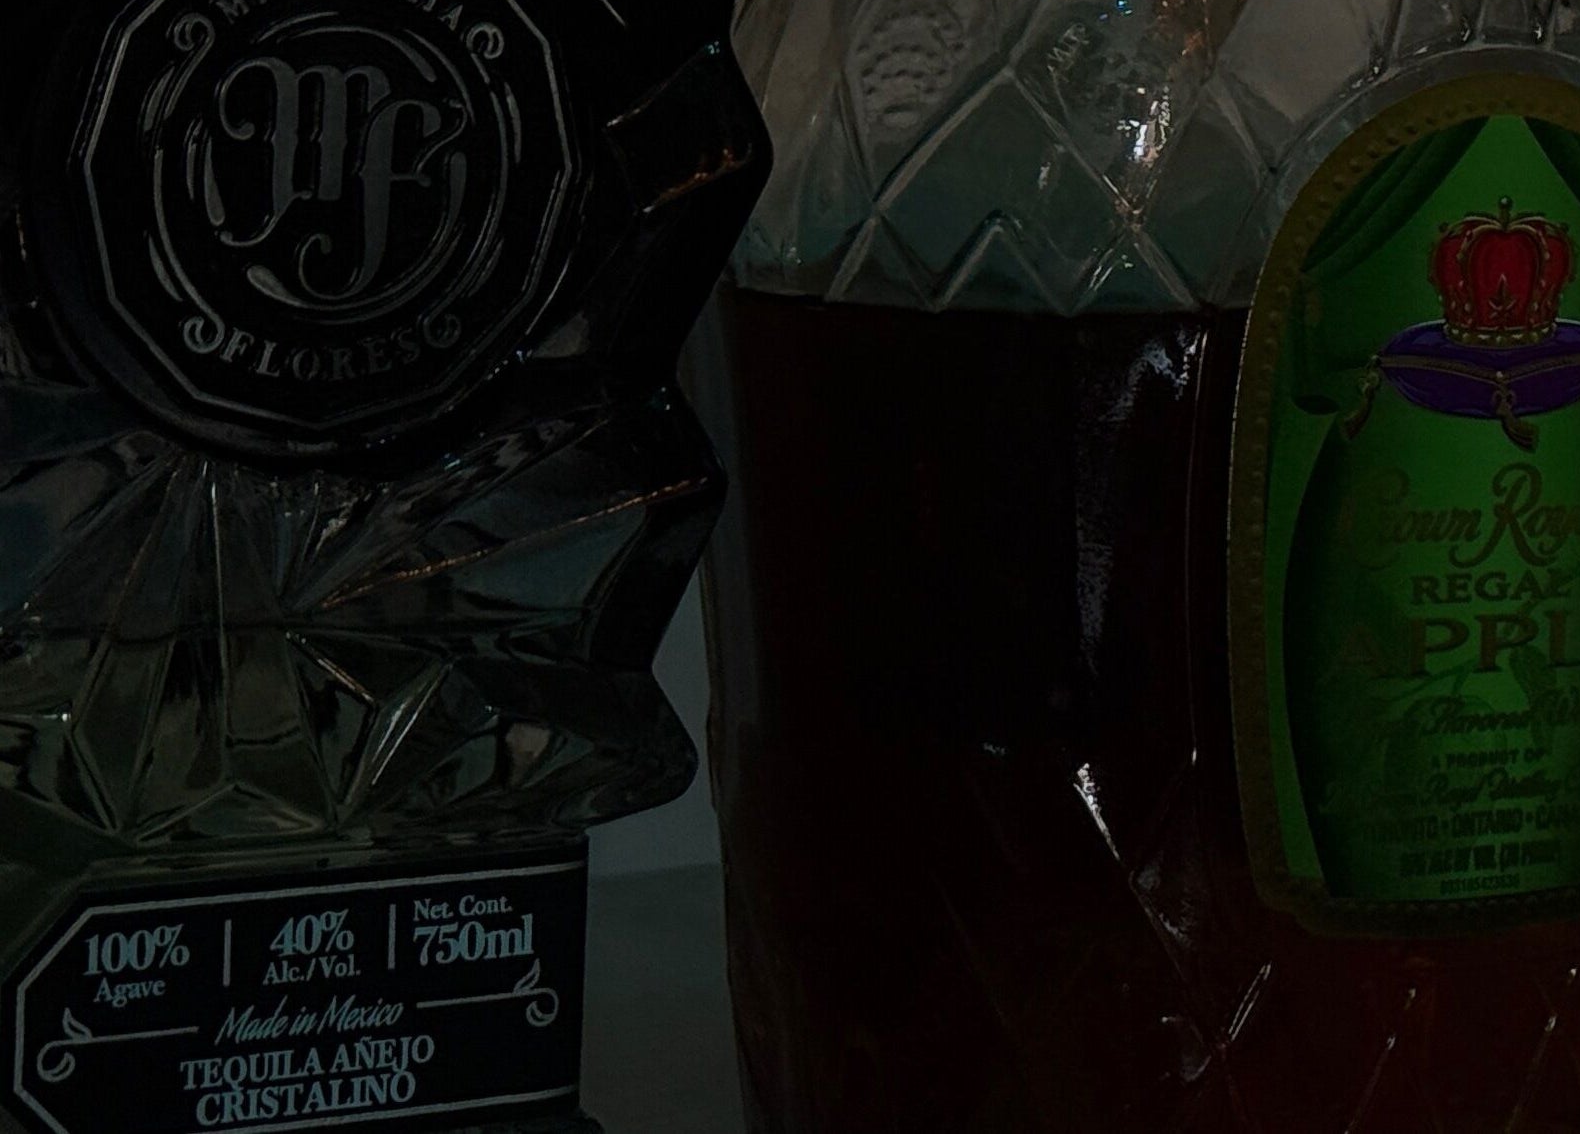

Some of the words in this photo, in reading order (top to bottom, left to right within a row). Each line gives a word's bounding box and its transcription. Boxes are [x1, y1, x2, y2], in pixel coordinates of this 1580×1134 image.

[219, 326, 424, 382] FLORES
[1410, 568, 1572, 606] REGAL
[268, 908, 356, 958] 40%
[458, 893, 513, 920] Cont.
[83, 922, 191, 978] 100%
[412, 914, 535, 967] 750ml
[93, 976, 167, 1009] Agave
[262, 956, 363, 988] Alc./Vol.
[213, 994, 290, 1047] Made
[288, 1005, 319, 1037] in
[316, 993, 405, 1035] Mexico
[179, 1046, 326, 1092] TEQUILA
[328, 1033, 436, 1074] AÑEJO
[195, 1070, 417, 1128] CRISTALINO
